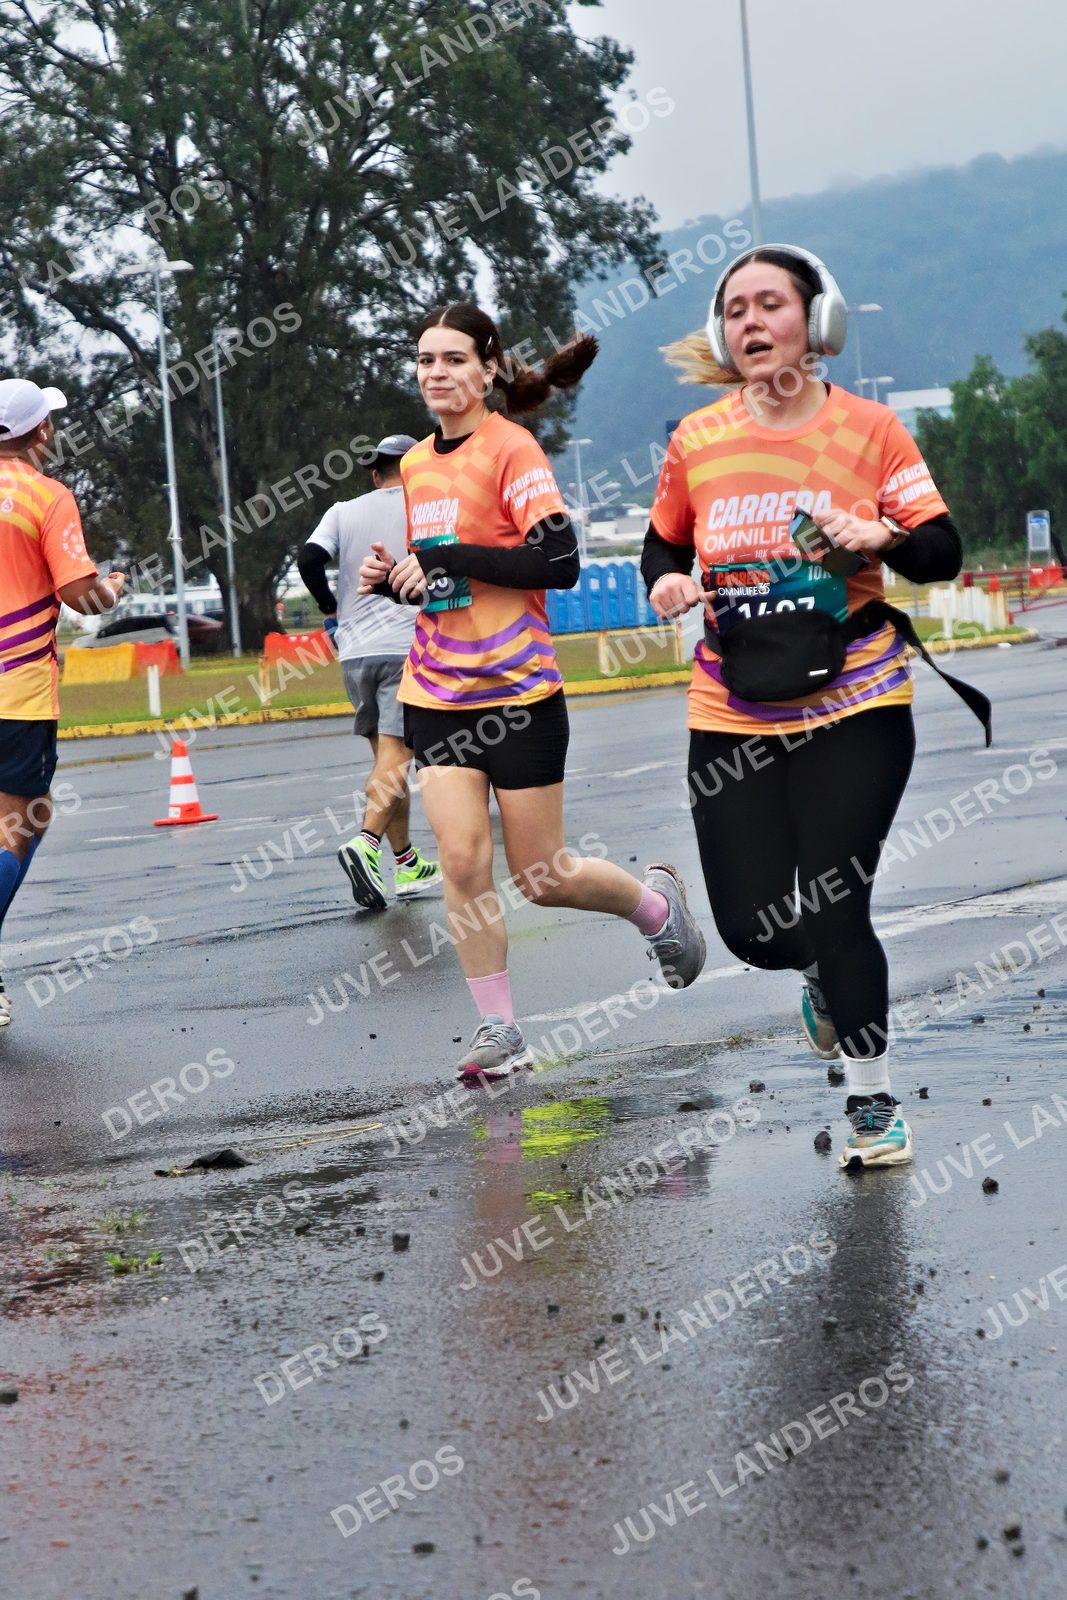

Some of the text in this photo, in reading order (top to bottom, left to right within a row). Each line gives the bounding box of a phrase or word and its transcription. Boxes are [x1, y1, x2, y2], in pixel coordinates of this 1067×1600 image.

[411, 498, 458, 527] CARRERA
[708, 490, 832, 531] CARRERA
[704, 524, 793, 553] OMNILIF
[716, 570, 770, 587] CARRERA
